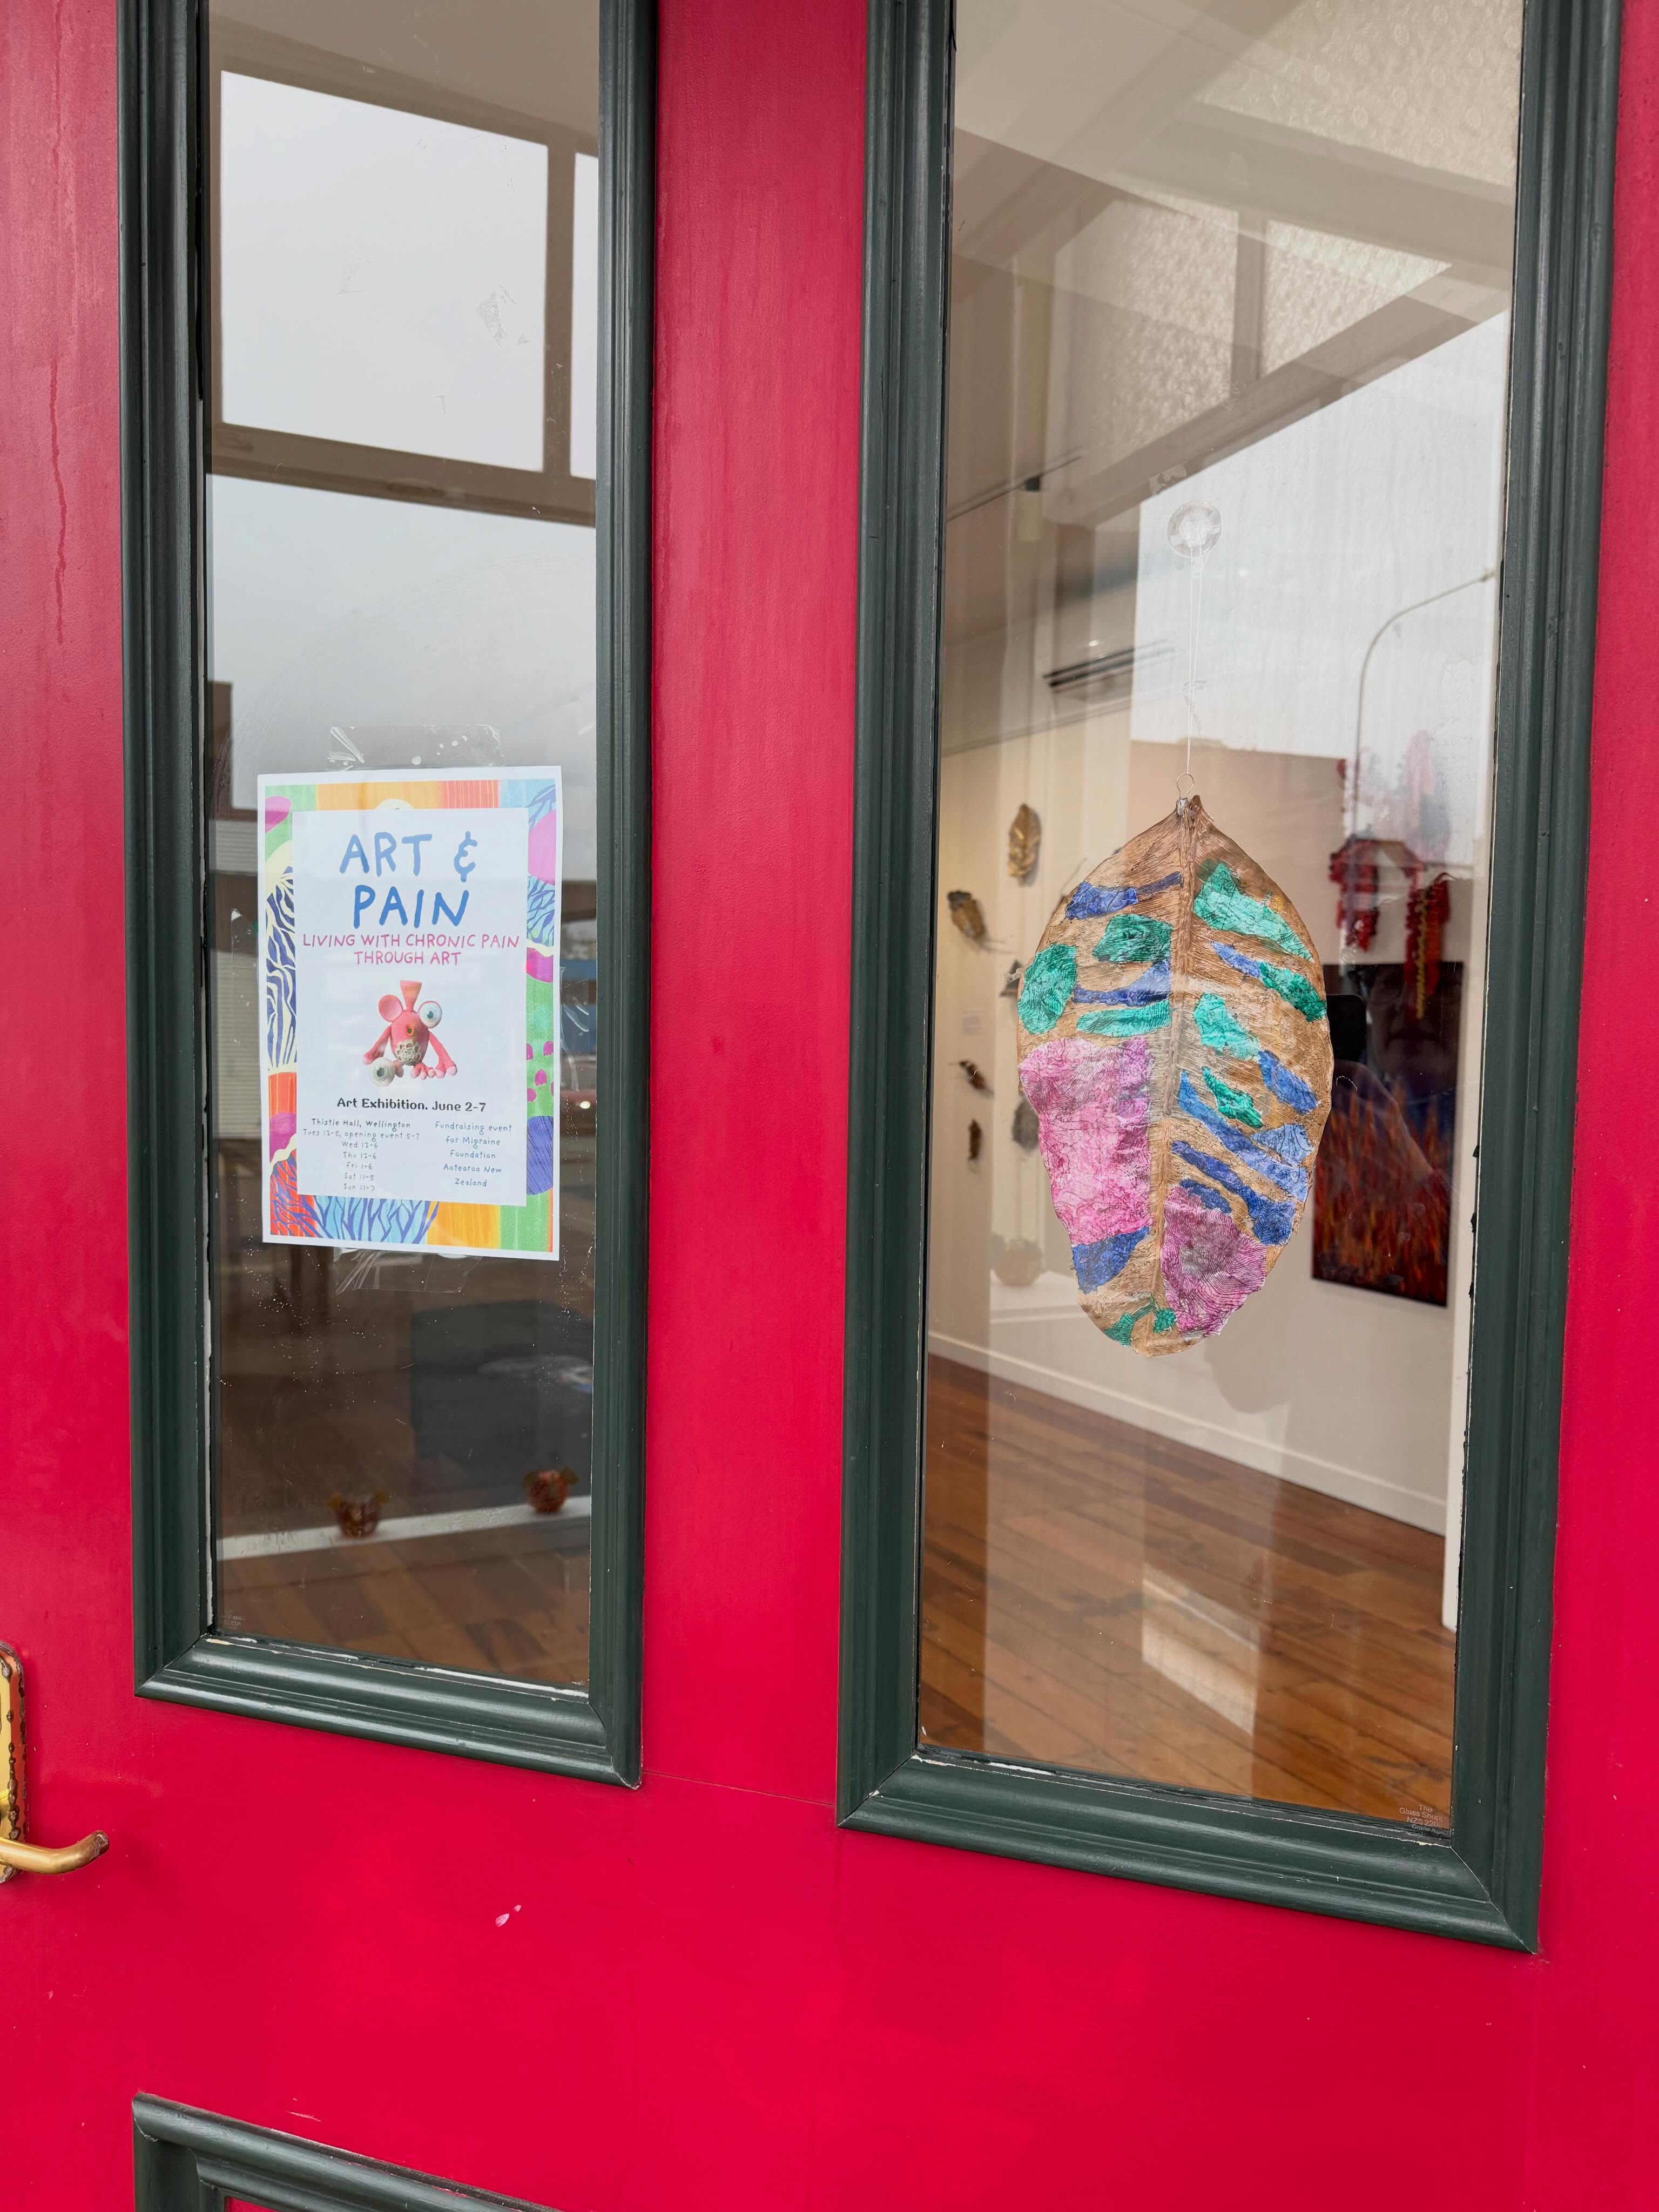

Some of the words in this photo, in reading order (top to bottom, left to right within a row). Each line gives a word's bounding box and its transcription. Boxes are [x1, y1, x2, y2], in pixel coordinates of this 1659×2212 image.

[339, 832, 433, 877] ART
[453, 831, 478, 882] &
[353, 885, 469, 929] PAIN
[303, 934, 355, 947] LIVING
[360, 934, 401, 948] WITH
[406, 934, 476, 948] CHRONIC
[481, 934, 520, 948] PAIN
[354, 951, 424, 965] THROUGH
[430, 952, 462, 966] ART
[337, 1098, 358, 1108] Art
[362, 1098, 428, 1110] Exhibition.
[431, 1101, 461, 1111] June
[465, 1102, 486, 1112] 2-7
[343, 1120, 362, 1128] Hall,
[366, 1120, 410, 1132] Wellington
[435, 1121, 484, 1135] Fundraising
[345, 1130, 376, 1142] opening
[446, 1135, 458, 1144] for
[462, 1136, 501, 1149] Migraine
[450, 1150, 496, 1159] Foundation
[443, 1163, 480, 1172] Aotearoa
[455, 1178, 487, 1187] Zealand
